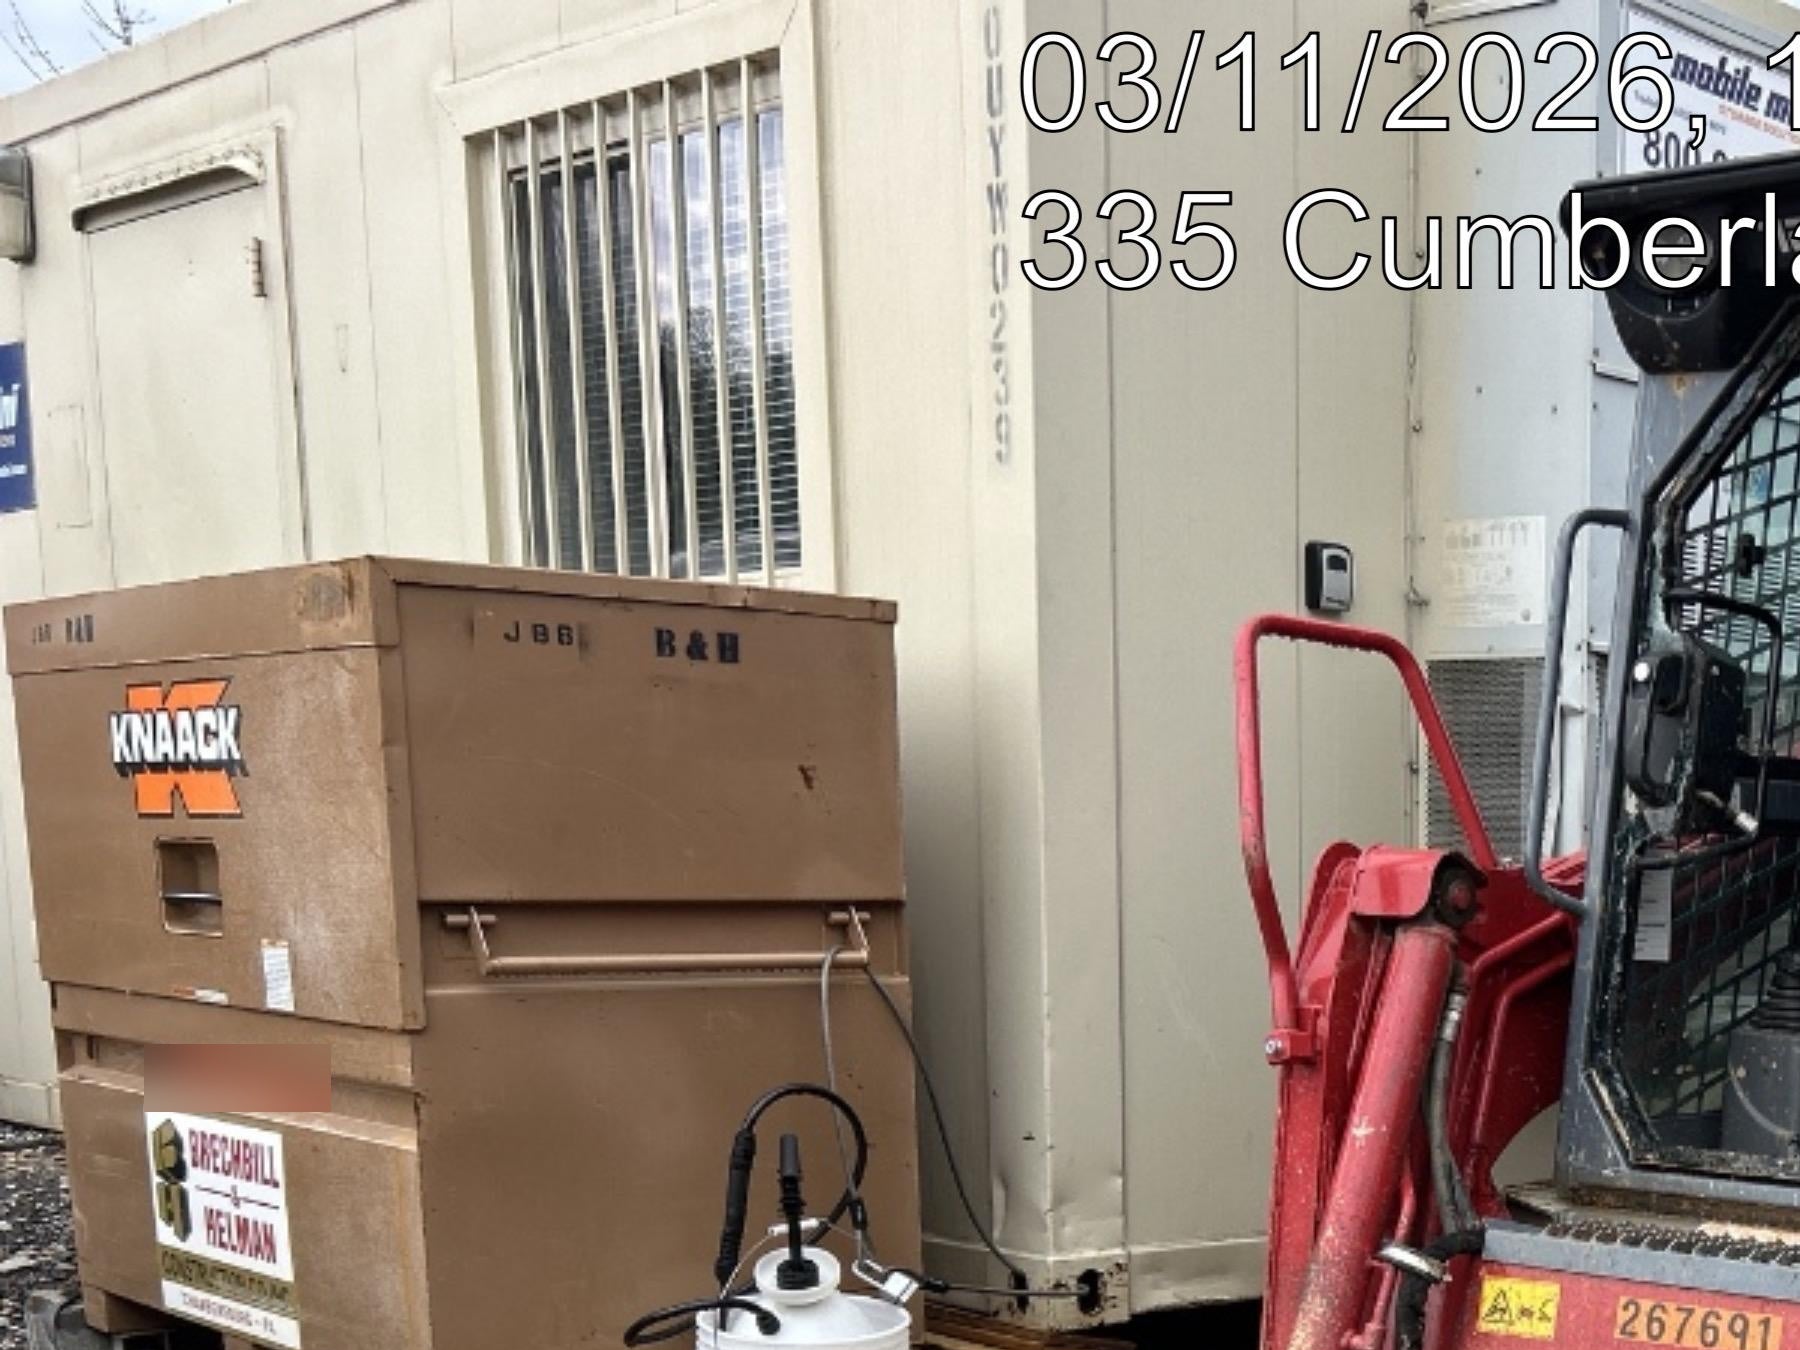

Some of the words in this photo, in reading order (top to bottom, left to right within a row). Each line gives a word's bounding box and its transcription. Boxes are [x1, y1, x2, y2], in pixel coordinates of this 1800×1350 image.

[1671, 52, 1761, 112] mobile
[109, 705, 248, 776] KNAACK
[188, 1127, 280, 1189] BRECHBILL
[202, 1204, 278, 1265] HELMAN
